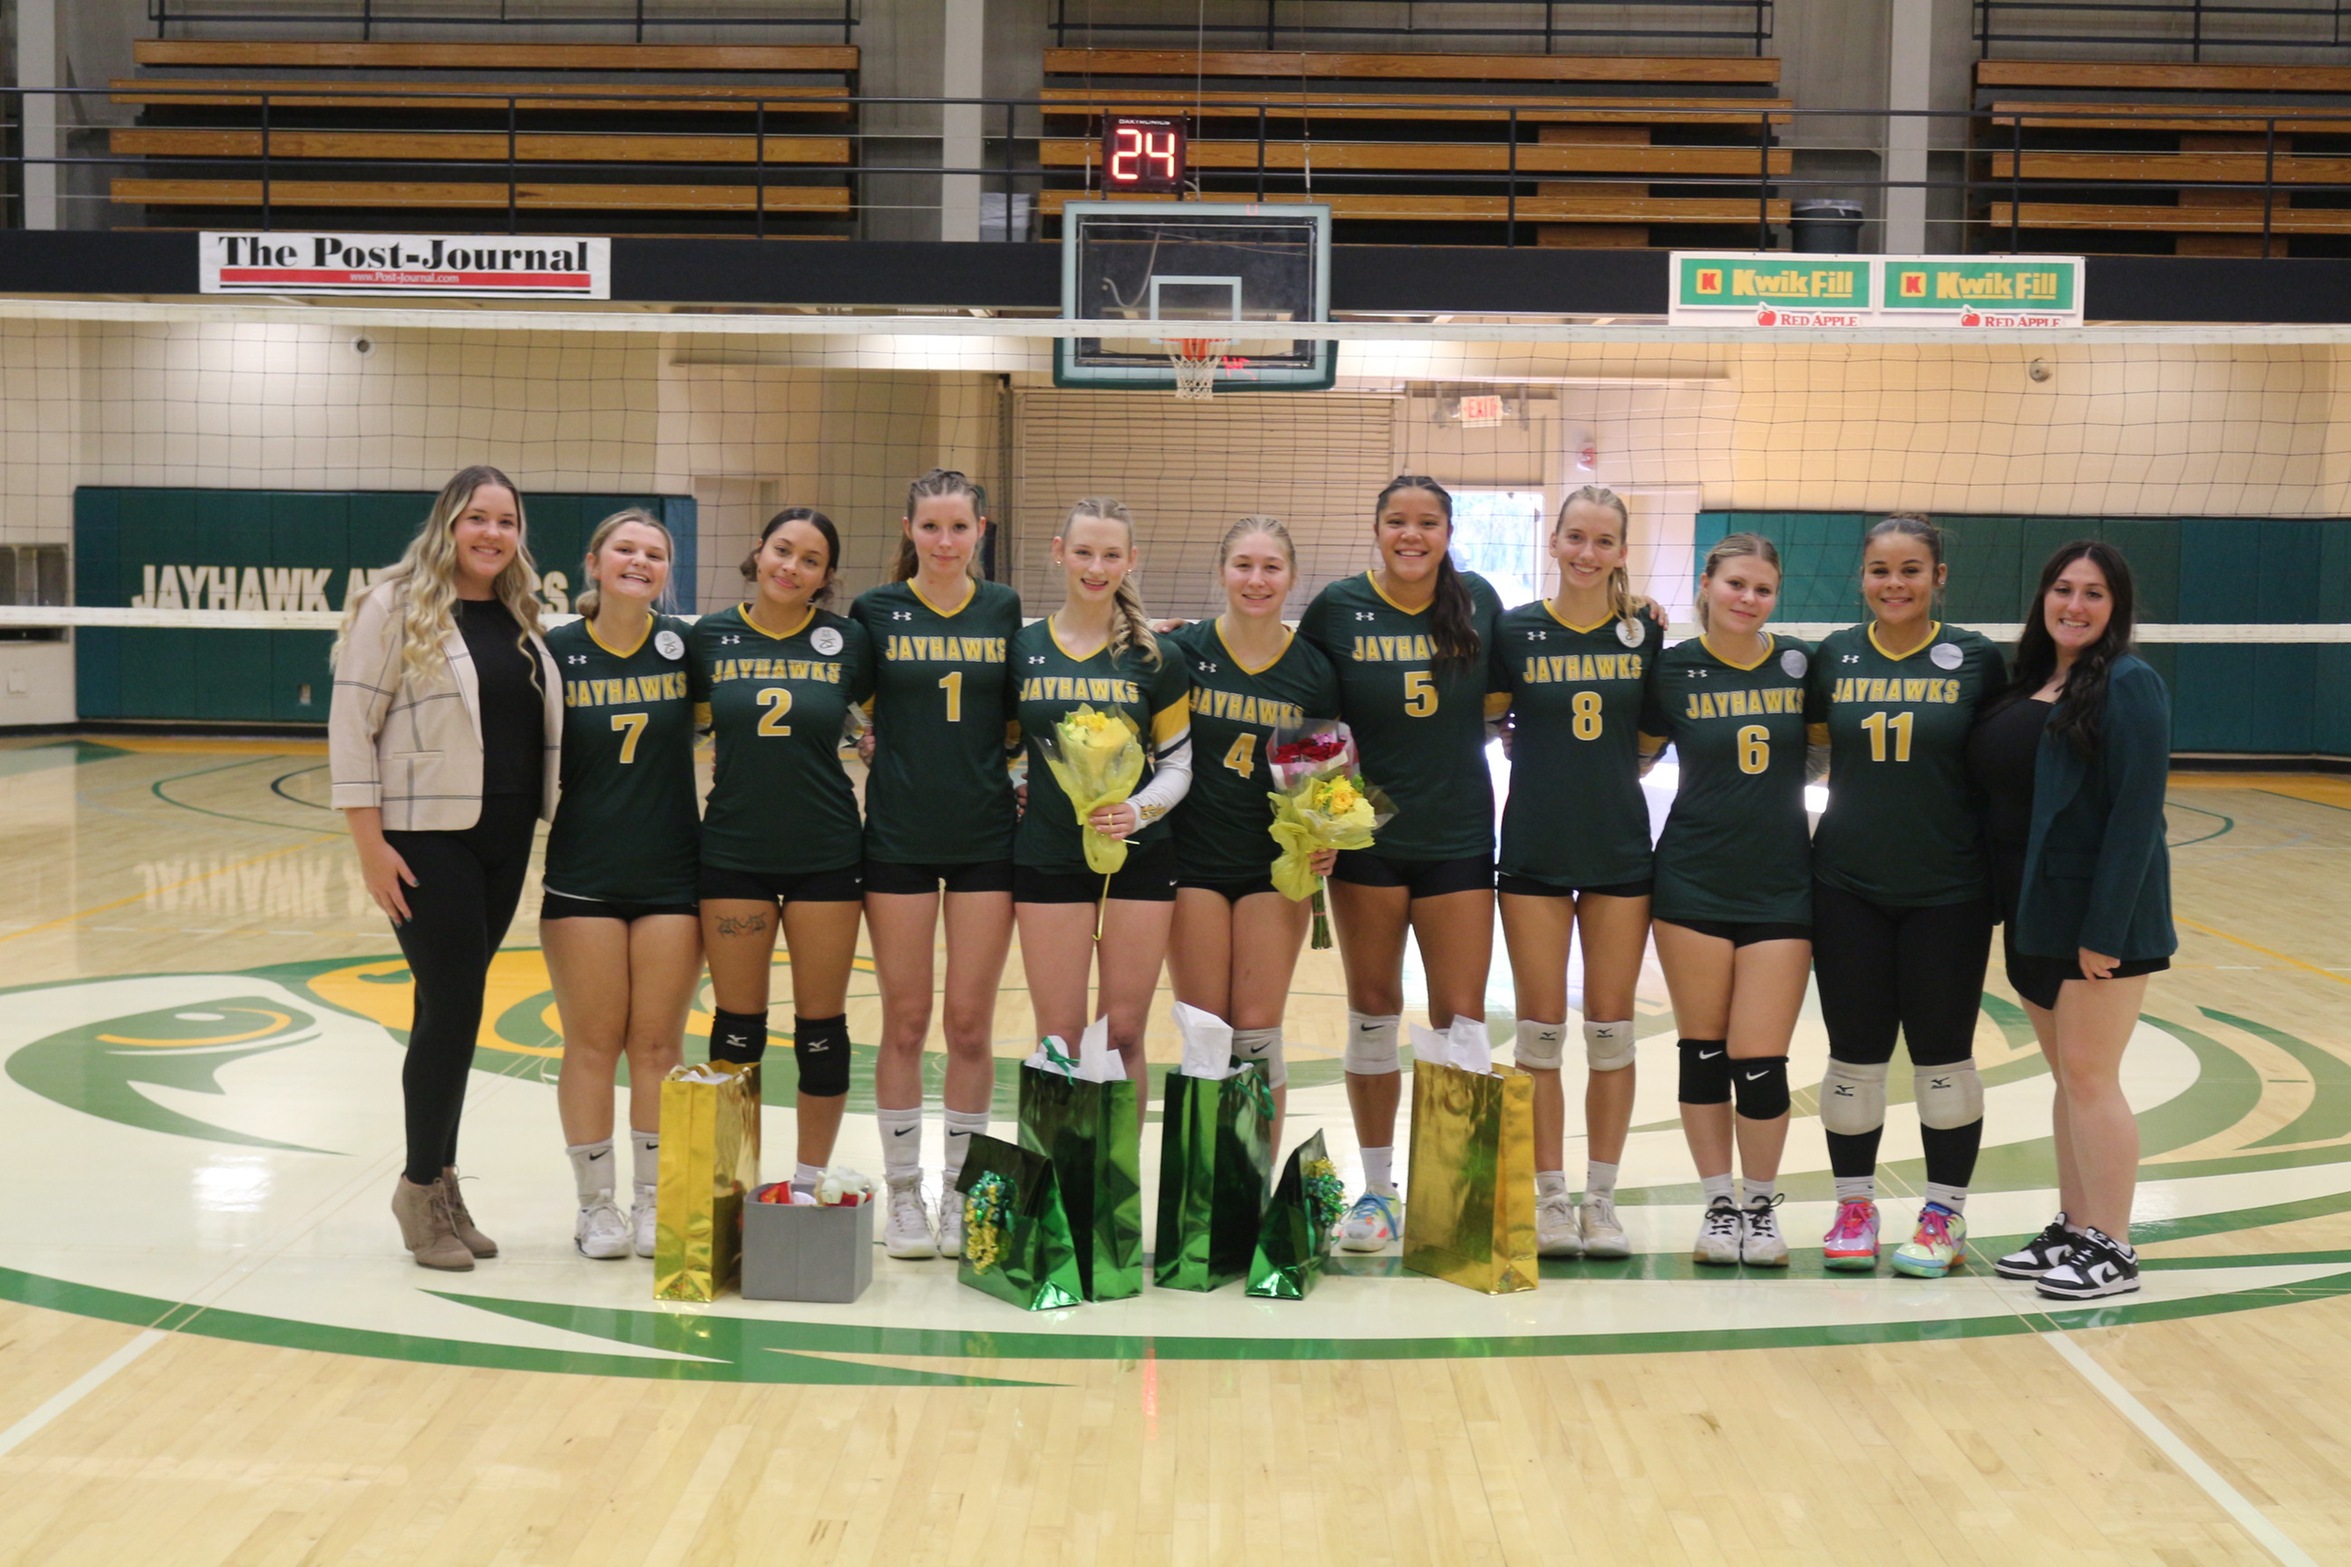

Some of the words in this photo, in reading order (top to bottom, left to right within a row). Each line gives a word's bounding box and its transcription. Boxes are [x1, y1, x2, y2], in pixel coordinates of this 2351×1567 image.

[1112, 129, 1175, 180] 24
[218, 236, 298, 267] The
[312, 237, 590, 273] Post-Journal
[1780, 314, 1810, 327] RED
[1812, 313, 1858, 327] APPLE
[1467, 398, 1497, 419] EXIT
[131, 565, 334, 612] JAYHAWK
[885, 635, 1006, 663] JAYHAWKS
[1352, 634, 1440, 661] JAYHA
[712, 659, 842, 684] JAYHAWKS
[1523, 654, 1642, 683] JAYHAWKS
[565, 671, 687, 707] JAYHAWKS
[938, 671, 962, 722] 1
[1020, 676, 1139, 704] JAYHAWKS
[1404, 670, 1439, 718] 5
[1686, 687, 1805, 719] JAYHAWKS
[1832, 678, 1961, 703] JAYHAWKS
[756, 687, 792, 737] 2
[1572, 691, 1602, 741] 8
[611, 713, 649, 764] 7
[1737, 725, 1770, 774] 6
[1861, 711, 1914, 762] 11
[1223, 732, 1257, 779] 4
